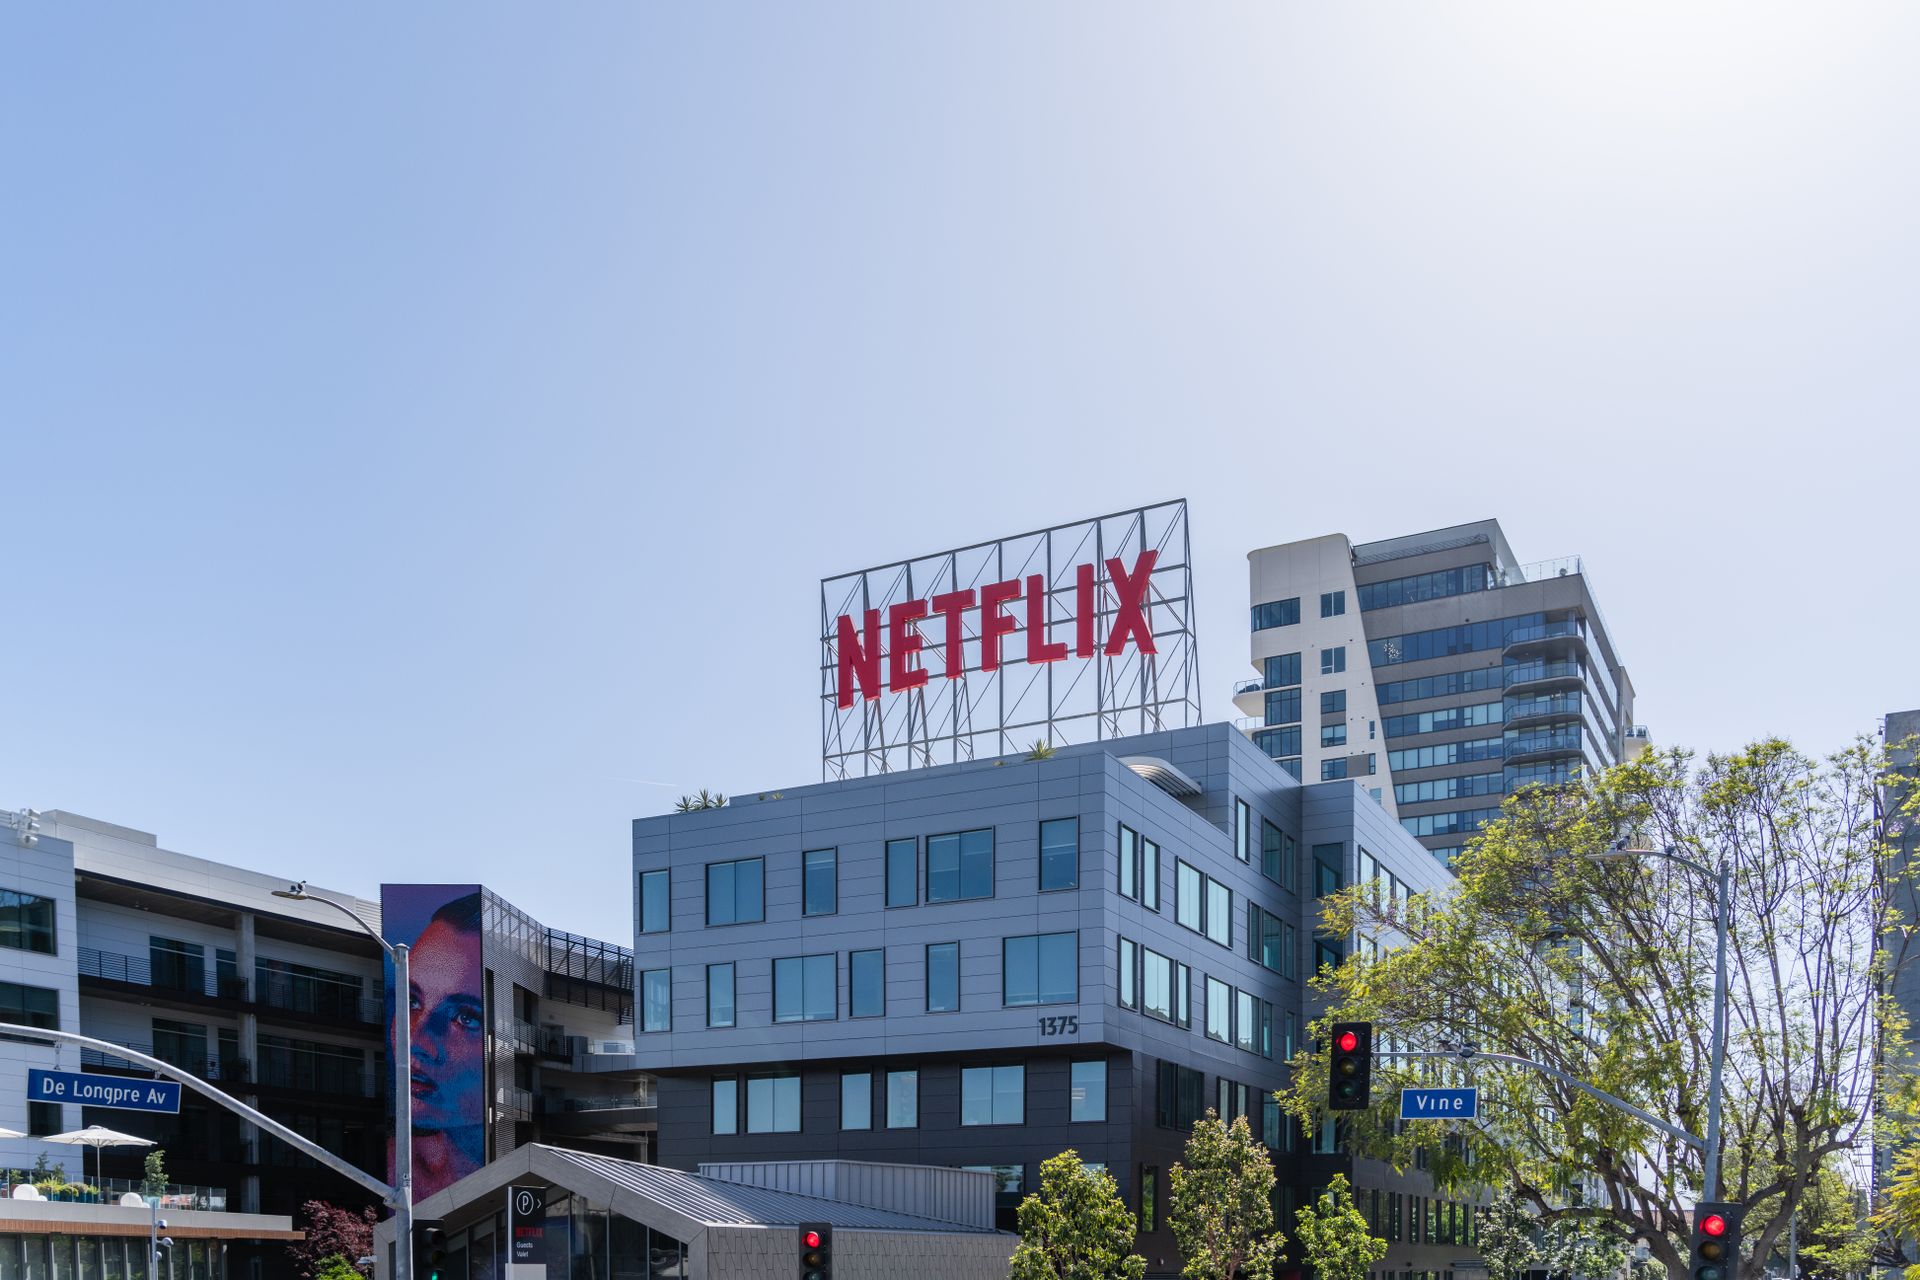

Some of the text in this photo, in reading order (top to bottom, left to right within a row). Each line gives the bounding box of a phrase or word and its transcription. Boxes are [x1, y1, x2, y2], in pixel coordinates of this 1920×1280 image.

[837, 550, 1158, 710] NETFLIX
[1038, 1015, 1078, 1036] 1375
[42, 1077, 166, 1105] De Longpre Av
[1416, 1095, 1463, 1110] Vine
